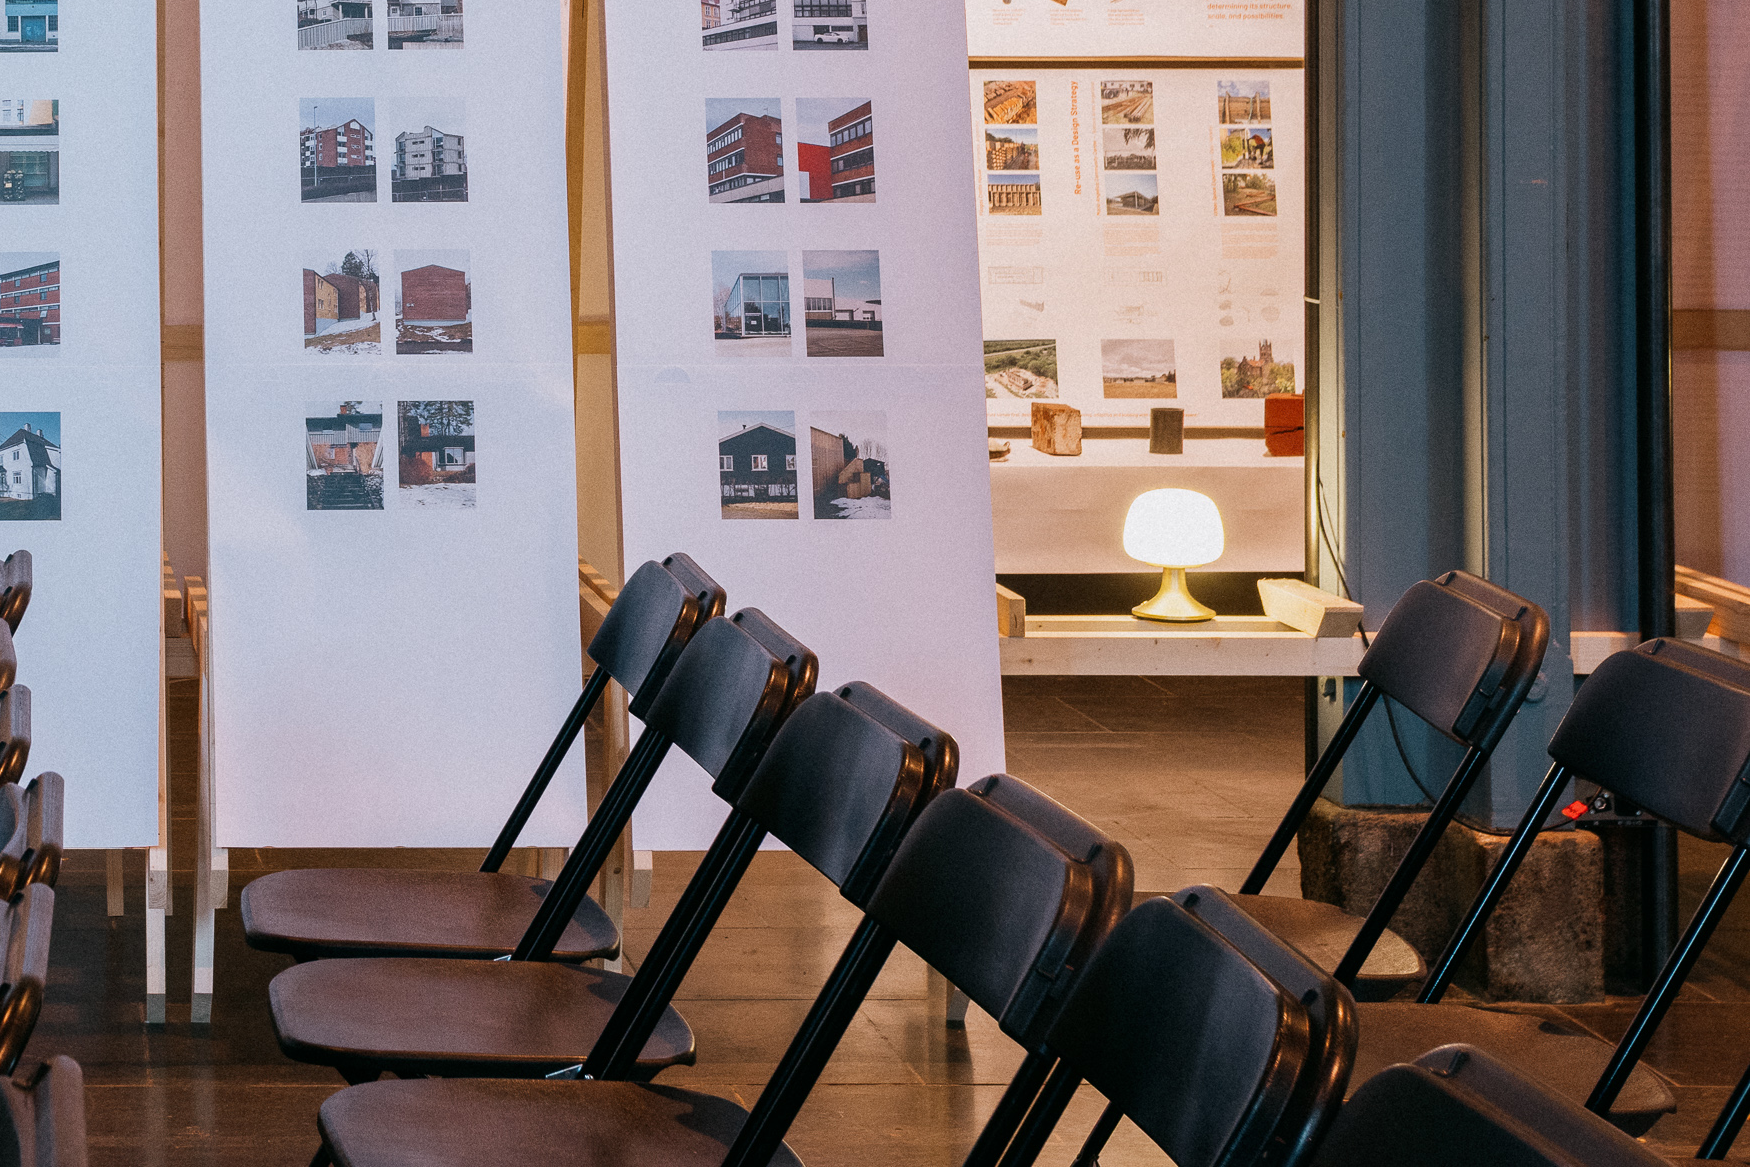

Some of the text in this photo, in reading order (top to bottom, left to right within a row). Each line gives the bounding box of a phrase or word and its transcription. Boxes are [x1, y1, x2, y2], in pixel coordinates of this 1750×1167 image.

[1070, 81, 1078, 116] Strategy
[1071, 118, 1079, 145] Design
[1074, 154, 1080, 163] as
